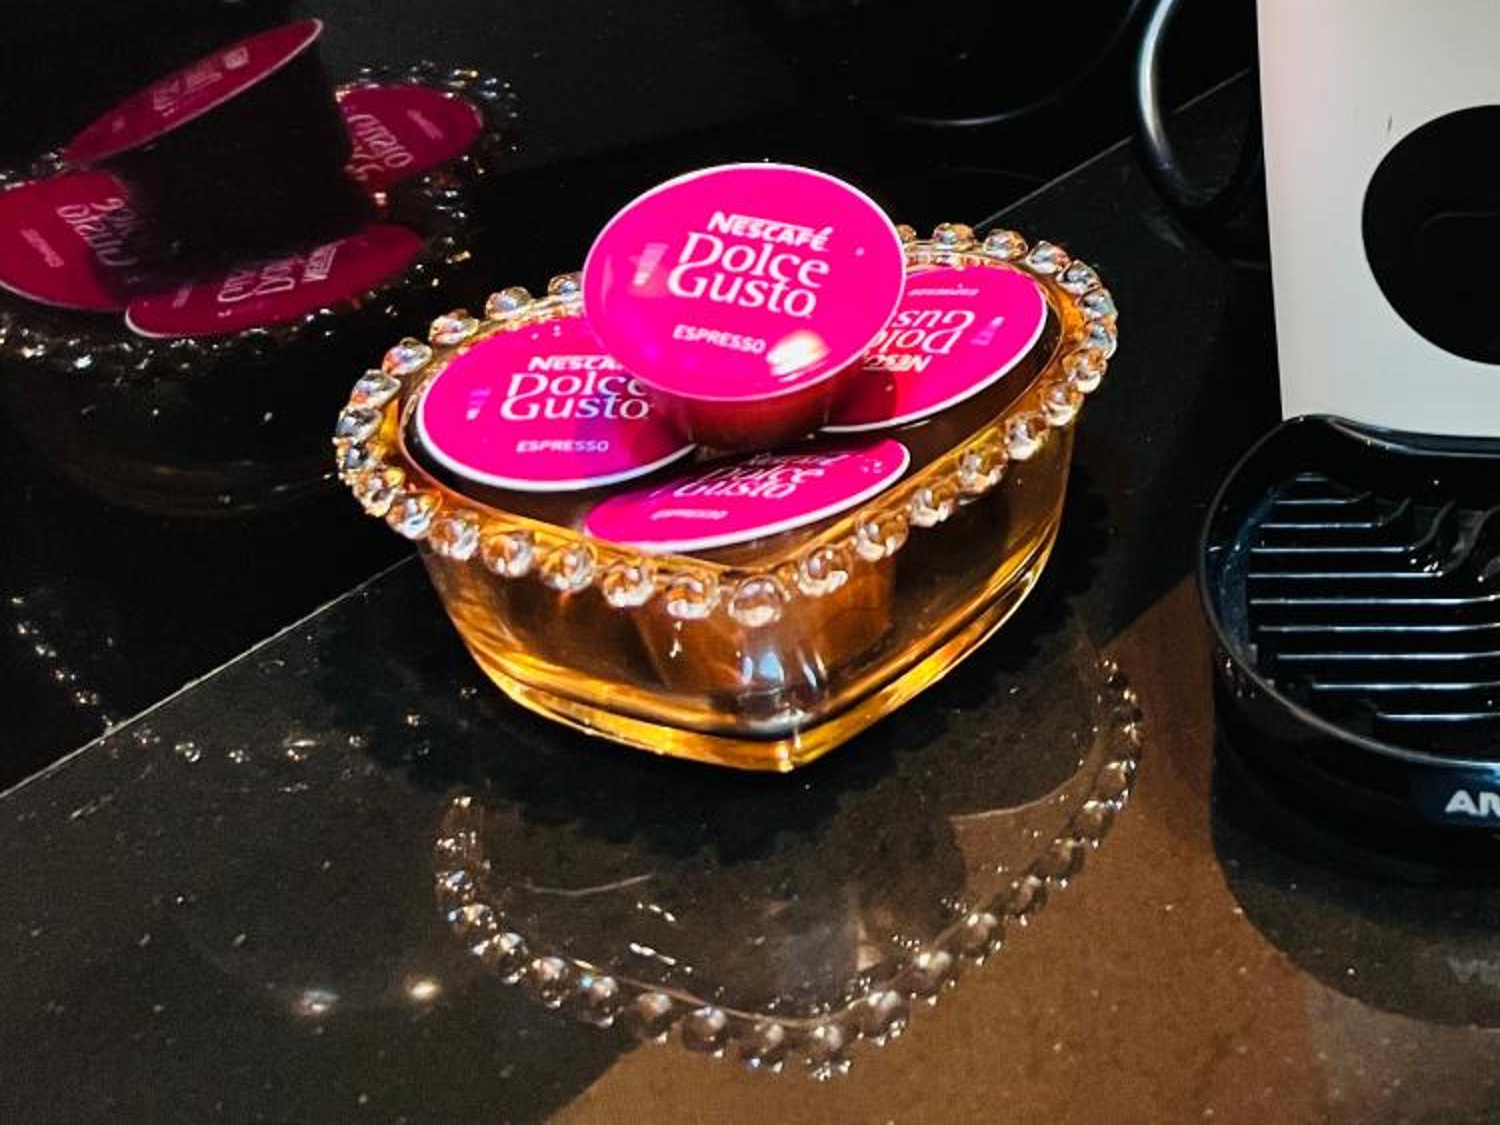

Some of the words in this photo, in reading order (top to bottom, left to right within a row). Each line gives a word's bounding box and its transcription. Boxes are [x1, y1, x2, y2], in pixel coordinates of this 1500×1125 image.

[707, 211, 833, 252] NESCAFÉ
[678, 231, 830, 288] Dolce
[667, 261, 817, 318] Gusto
[892, 310, 975, 332] Gus
[672, 323, 766, 354] ESPRESSO
[870, 329, 964, 355] Dolc
[528, 354, 624, 372] NESCA
[863, 354, 932, 372] NESC
[500, 394, 649, 421] Gusto
[516, 440, 609, 454] ESPRESSO
